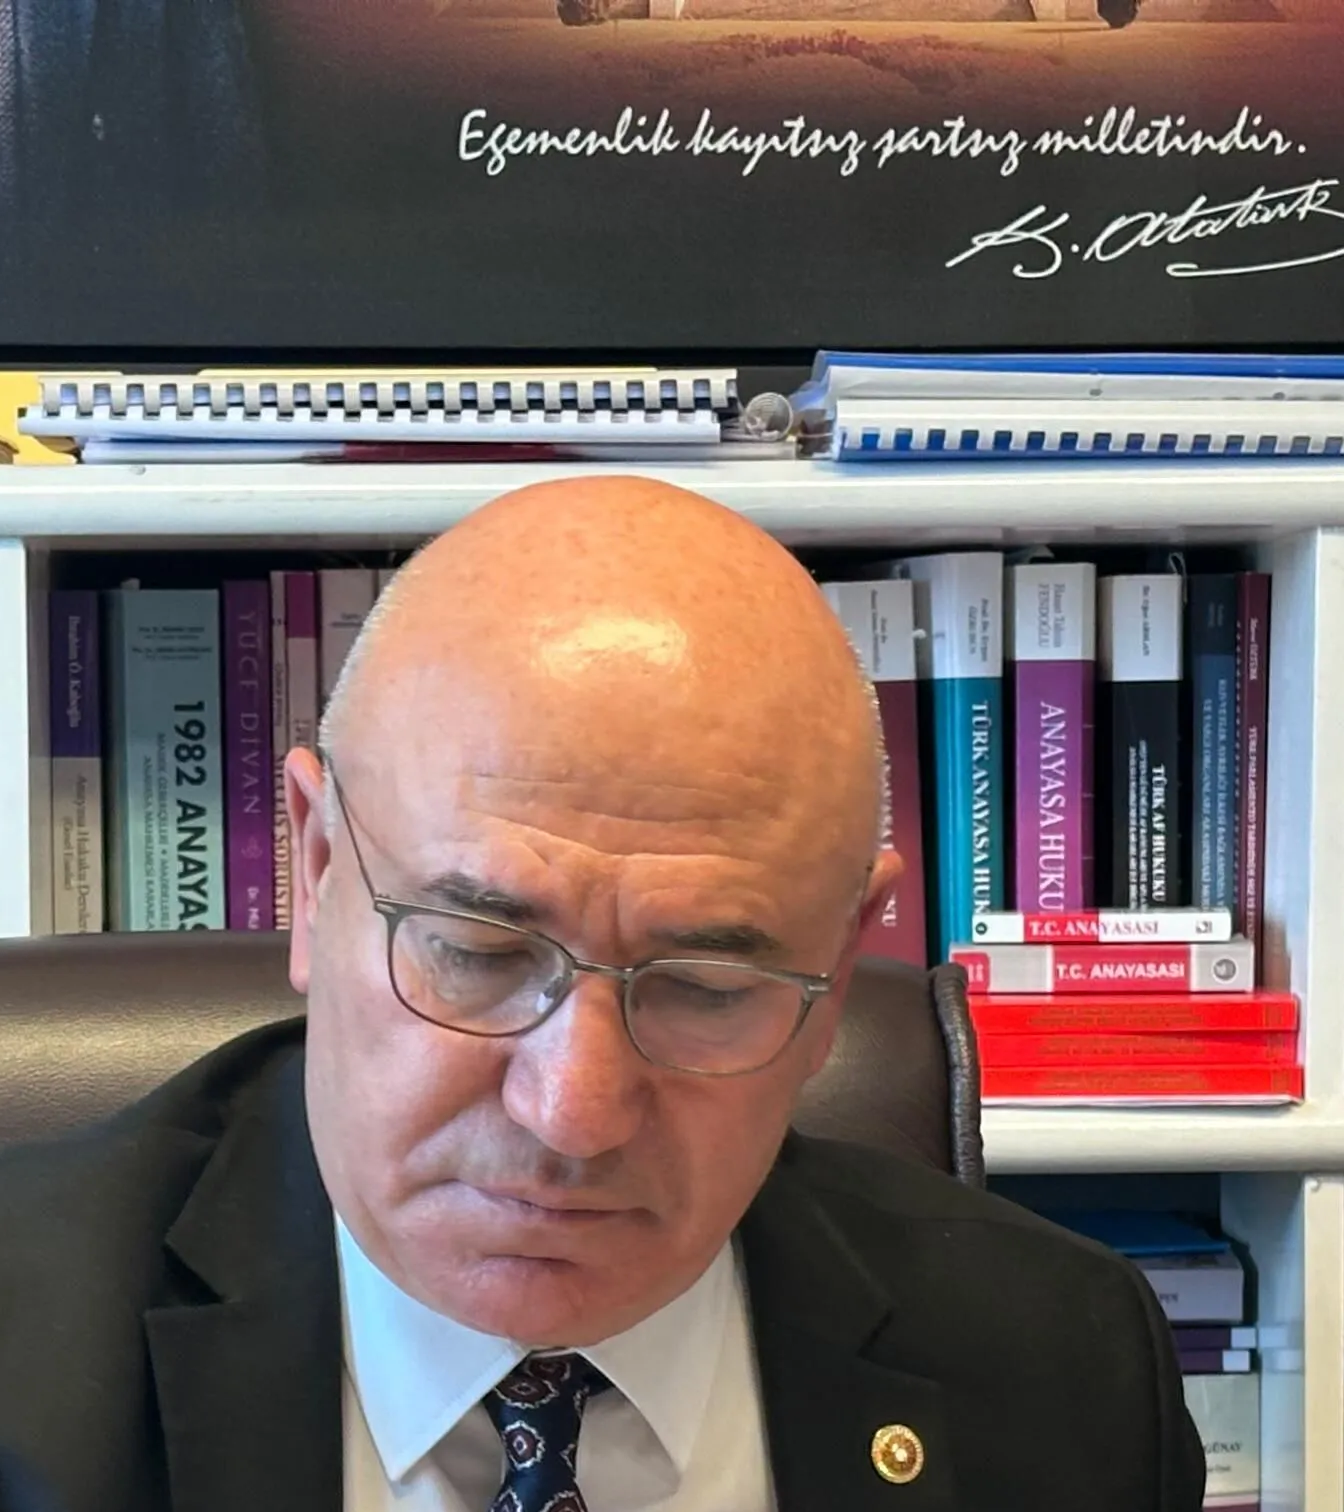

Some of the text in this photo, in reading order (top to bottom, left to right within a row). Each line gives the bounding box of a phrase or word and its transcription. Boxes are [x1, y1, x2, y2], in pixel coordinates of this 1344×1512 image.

[458, 107, 681, 174] Egemenlik
[687, 110, 864, 174] kayıtsız
[175, 700, 208, 787] 1982
[238, 712, 262, 815] DİVAN
[970, 701, 992, 763] TÜRK
[970, 765, 992, 862] ANAYASA
[1039, 701, 1066, 912] ANAYASA HUKU
[1152, 764, 1167, 902] TÜRK AF HUKUKU
[1030, 921, 1159, 936] T.C. ANAYASASI
[1056, 963, 1185, 979] T.C. ANAYASASI
